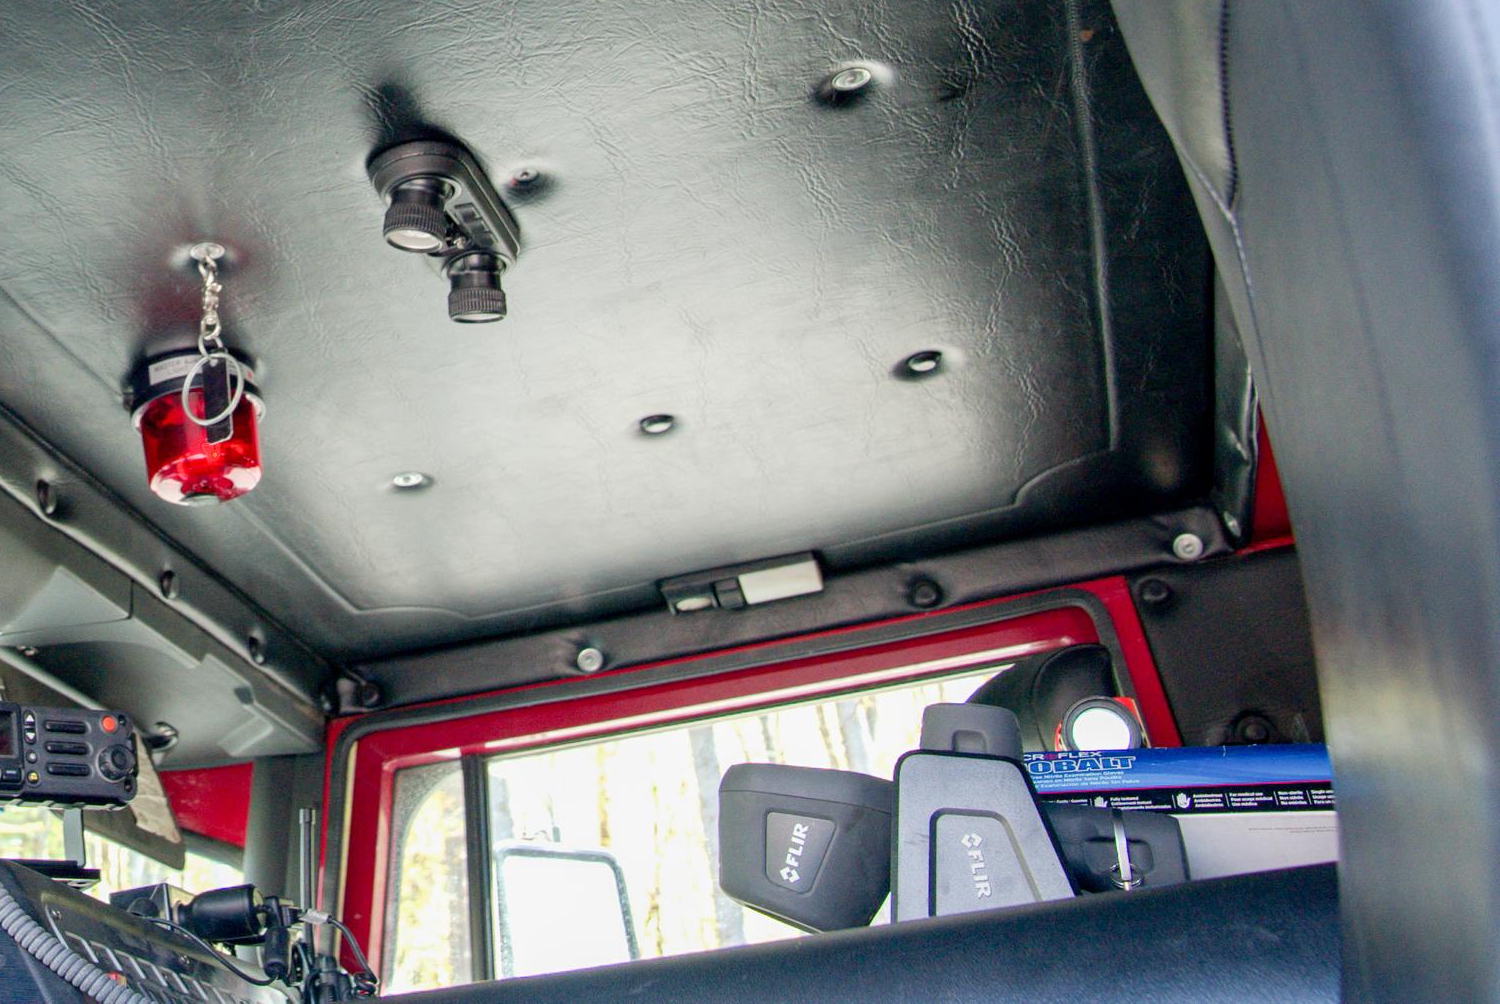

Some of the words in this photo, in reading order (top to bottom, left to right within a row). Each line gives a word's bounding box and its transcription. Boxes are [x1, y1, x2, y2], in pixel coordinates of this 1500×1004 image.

[1023, 751, 1102, 761] CROFLEX
[1025, 756, 1135, 775] OBALT
[786, 822, 809, 867] FLIR
[968, 849, 992, 899] FLIR
